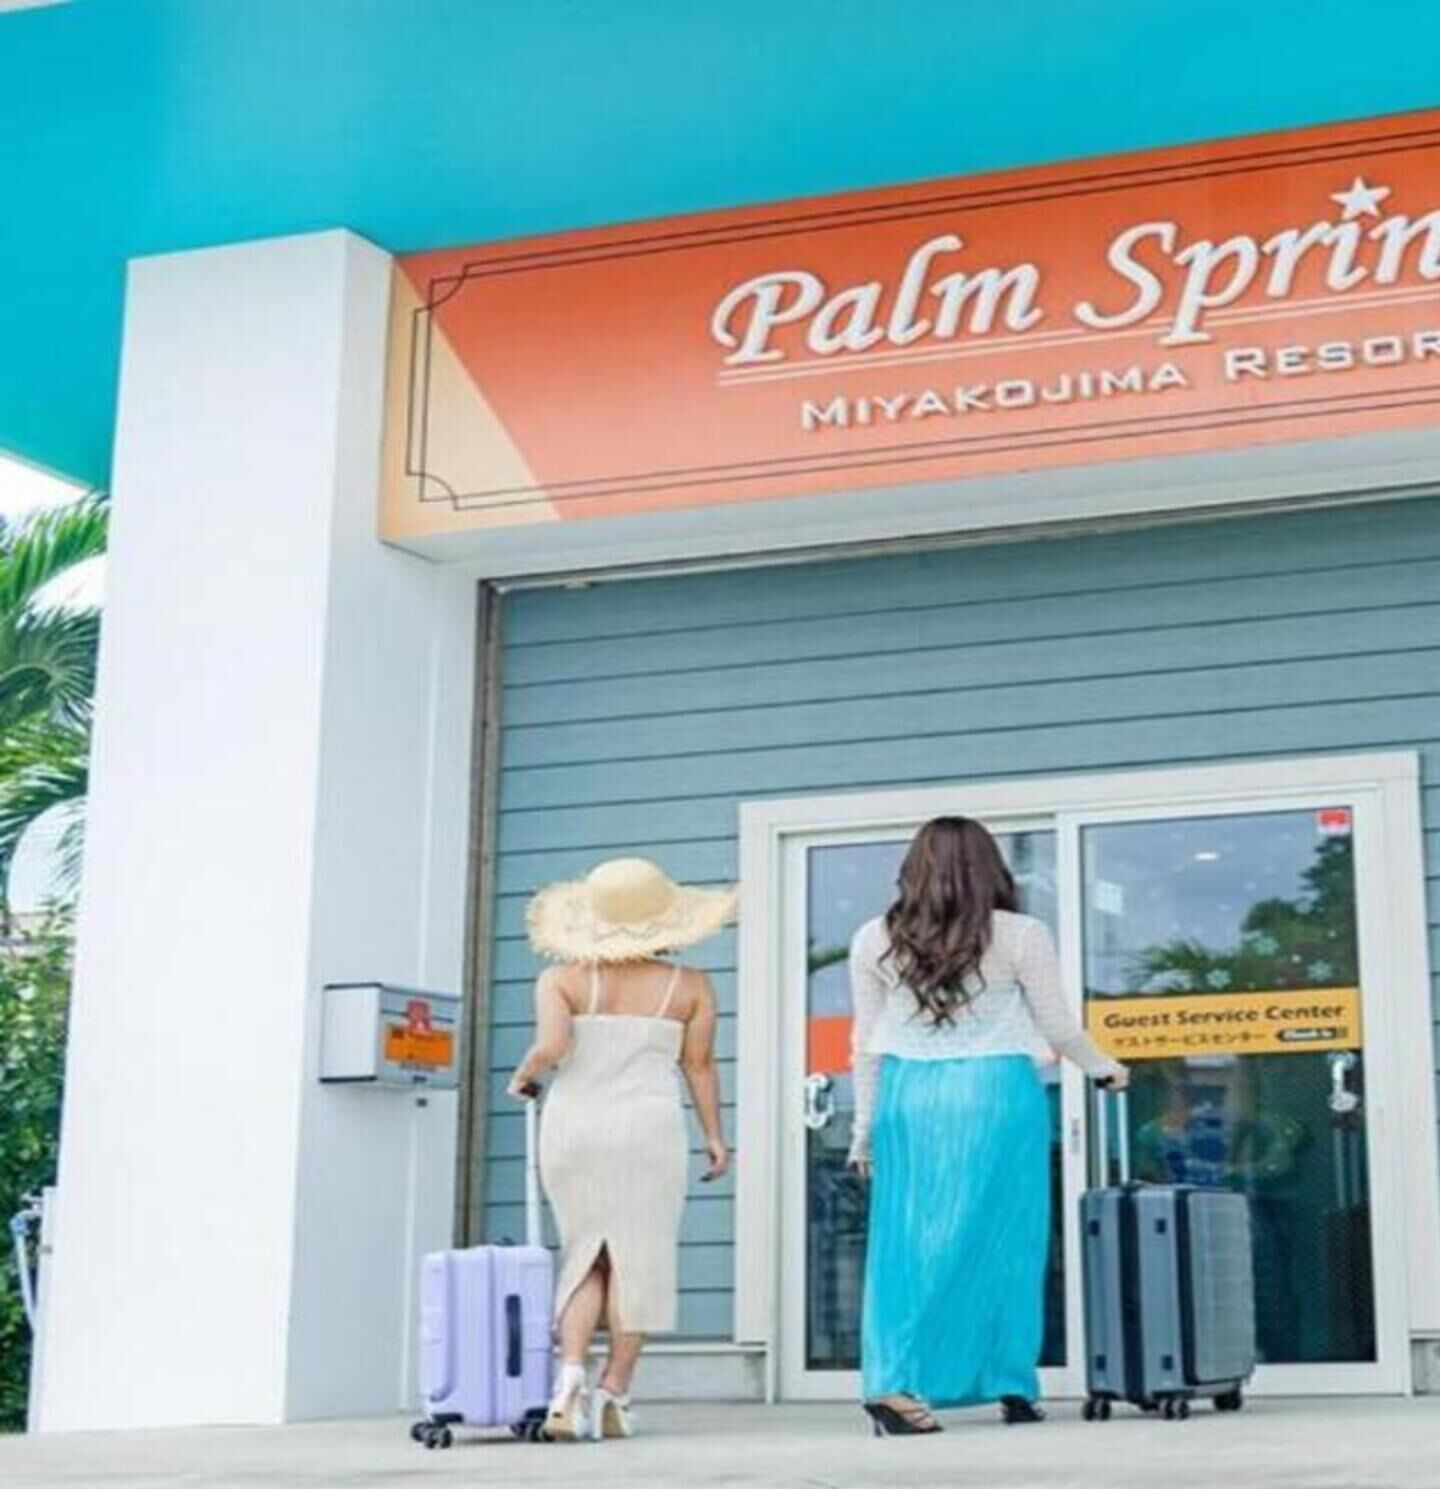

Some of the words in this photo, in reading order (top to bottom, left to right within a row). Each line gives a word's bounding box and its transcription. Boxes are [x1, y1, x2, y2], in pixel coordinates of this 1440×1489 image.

[711, 233, 1045, 364] Palm
[801, 362, 1189, 431] MIYAKOJIMA
[1104, 1012, 1171, 1029] Guest
[1177, 1008, 1259, 1025] Service
[1266, 1004, 1345, 1020] Center
